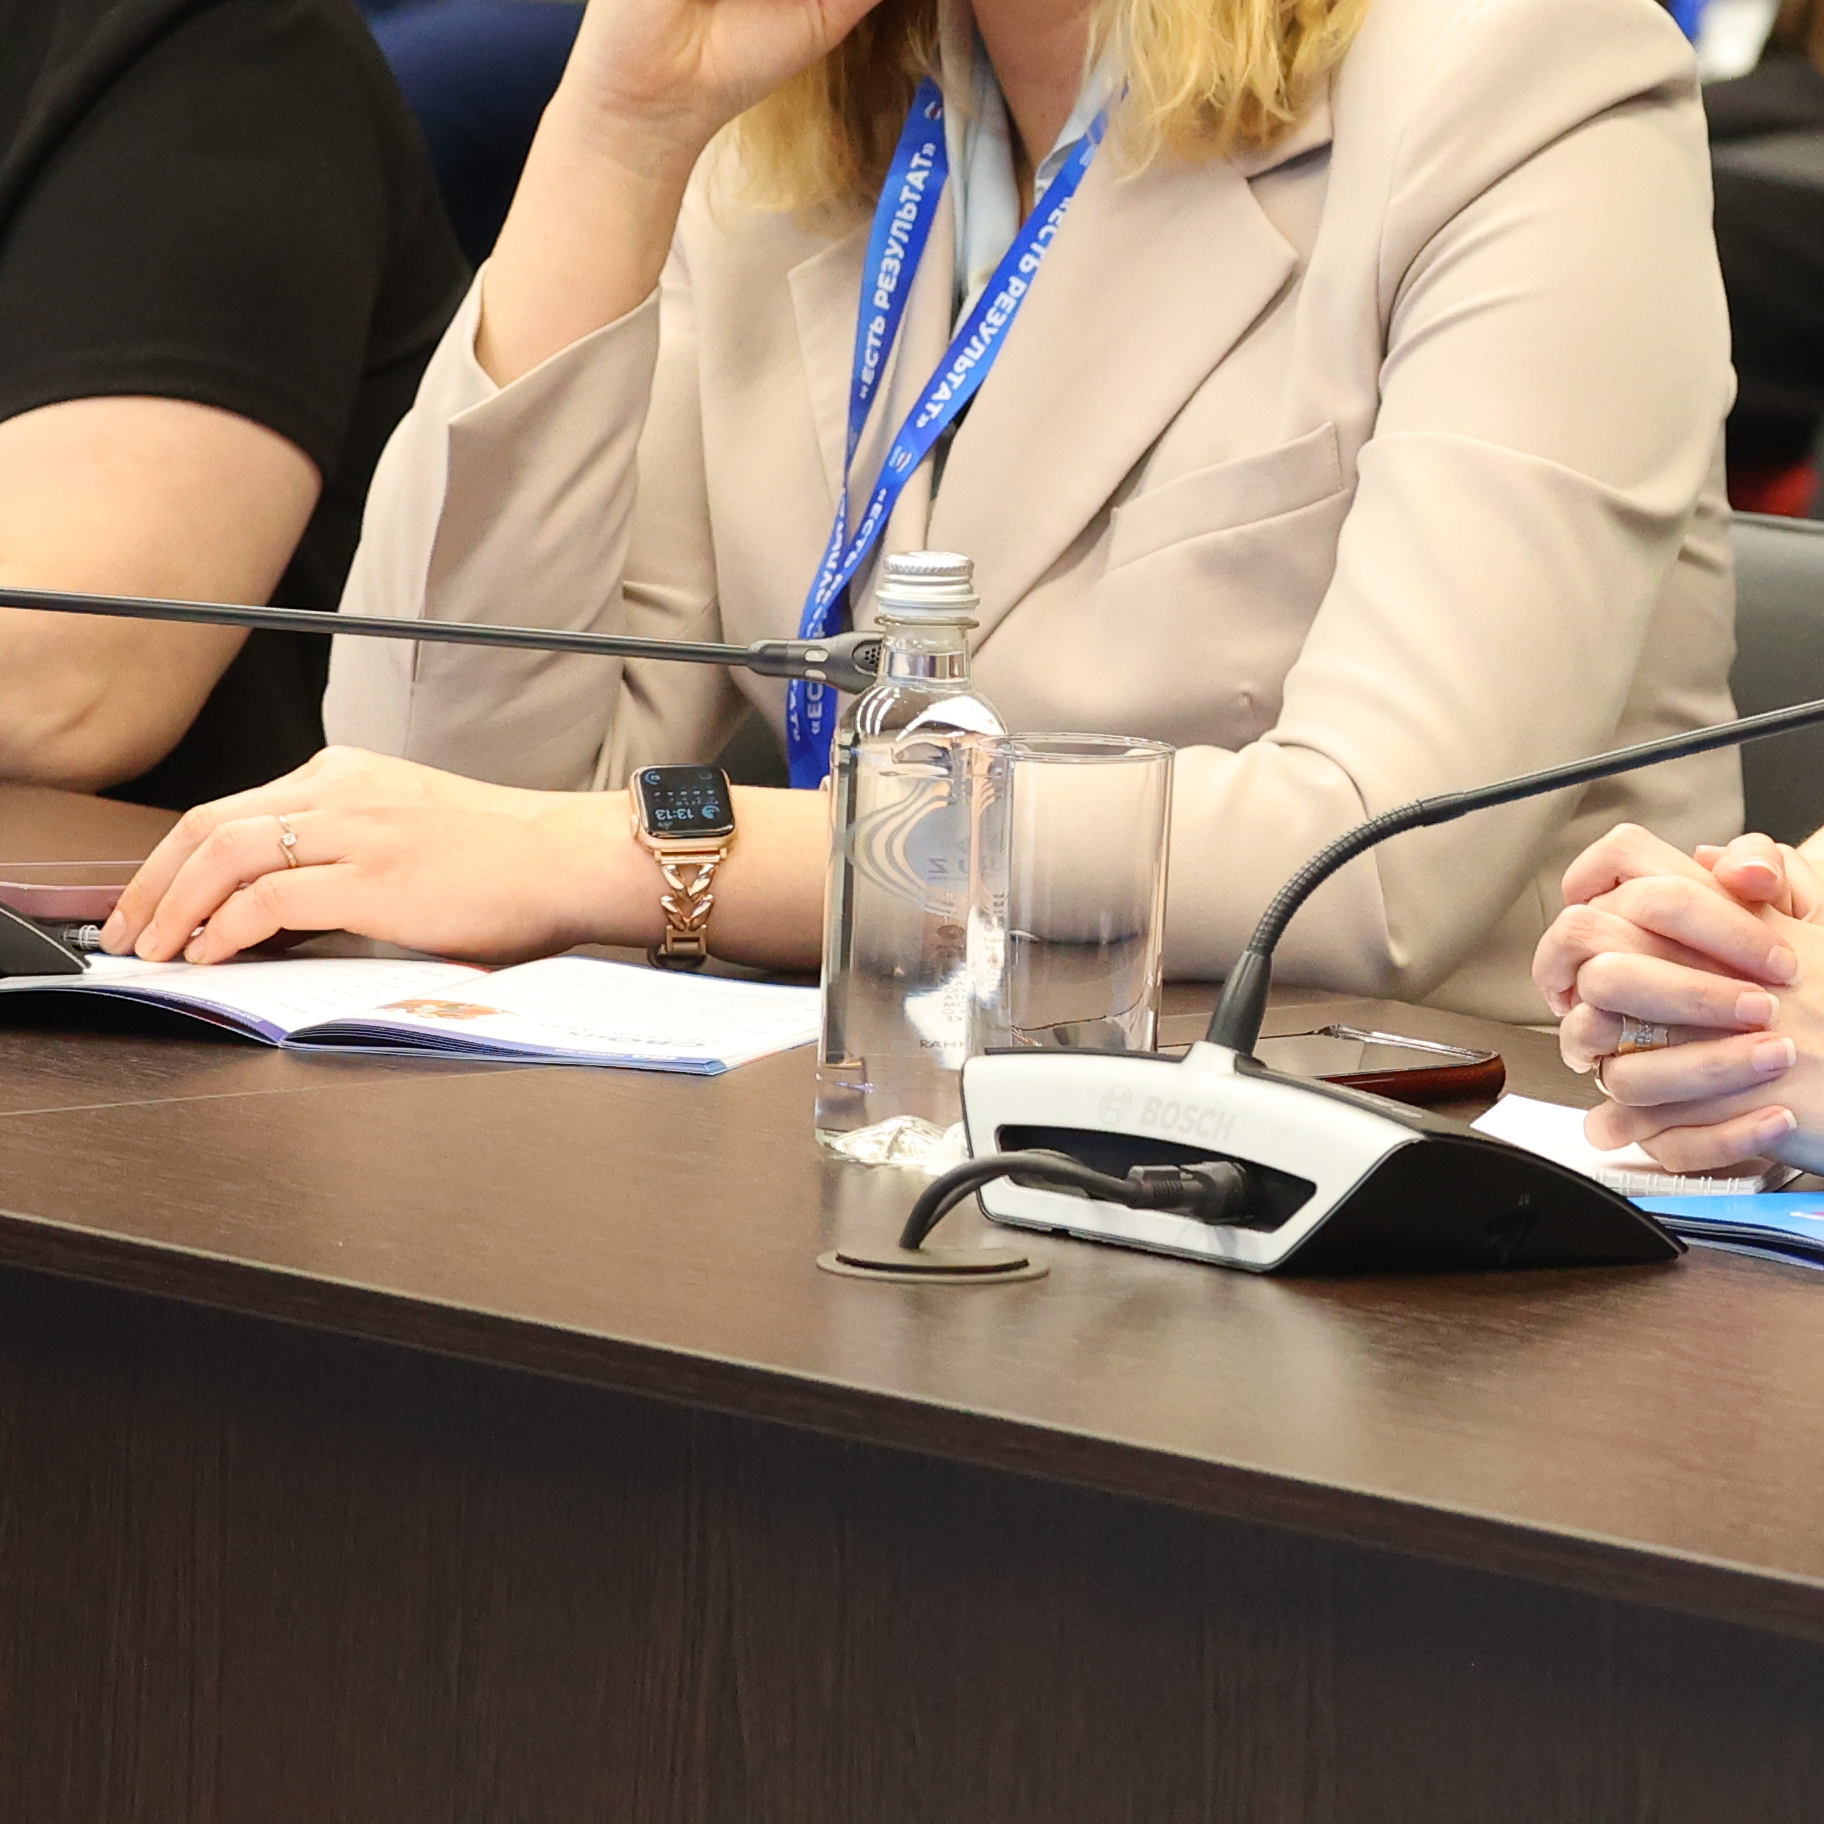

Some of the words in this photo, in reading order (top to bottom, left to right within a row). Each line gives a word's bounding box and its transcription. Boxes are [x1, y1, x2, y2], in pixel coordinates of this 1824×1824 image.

[859, 314, 886, 400] «ЕСТЬ
[873, 142, 937, 310] РЕЗУЛЬТАТ»
[915, 274, 1029, 429] РЕЗУЛЬТАТ»
[1139, 1095, 1237, 1142] BOSCH
